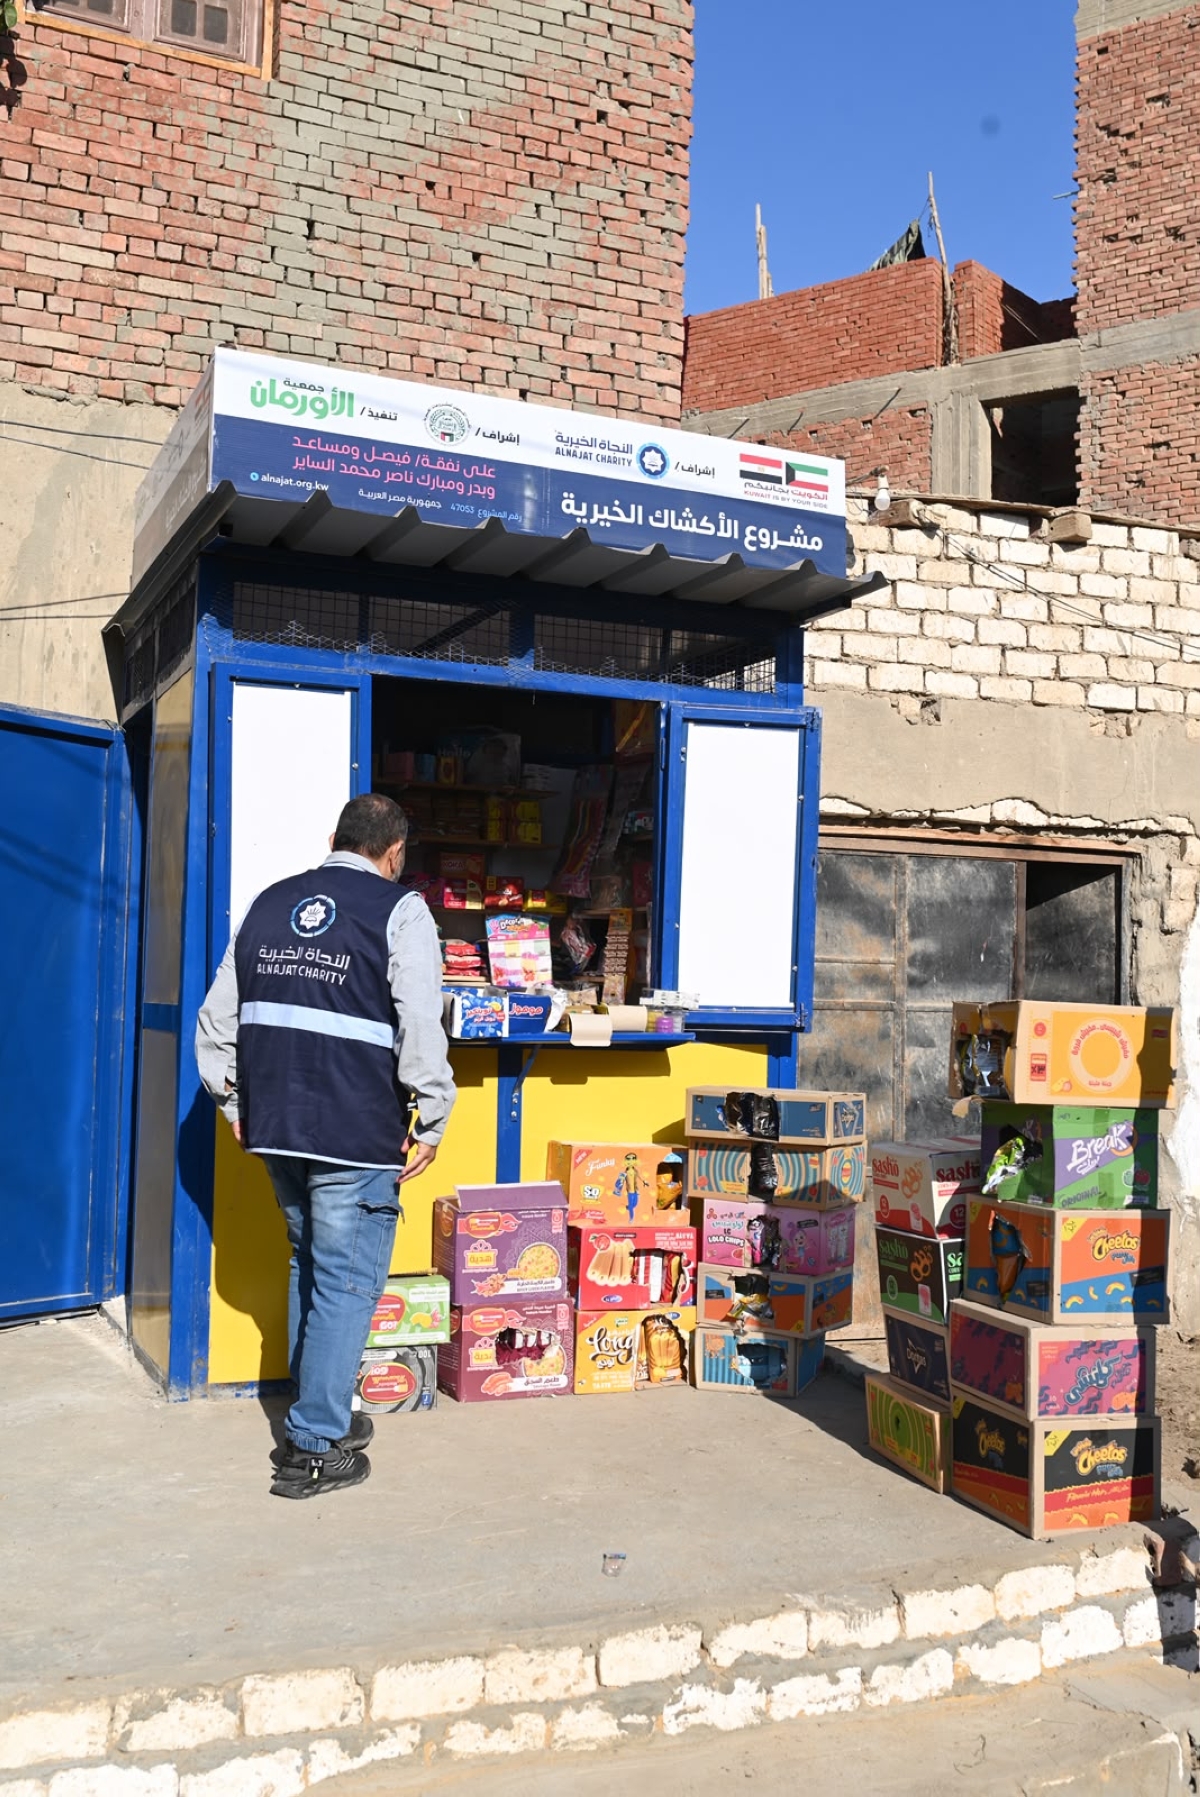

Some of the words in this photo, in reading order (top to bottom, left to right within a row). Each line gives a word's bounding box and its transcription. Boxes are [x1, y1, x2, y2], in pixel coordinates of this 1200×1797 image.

[283, 377, 325, 393] جمعية
[250, 378, 354, 419] الأورمان
[555, 430, 598, 451] الخيرية
[599, 438, 633, 455] النجاة
[292, 453, 335, 472] الساير
[363, 446, 411, 464] فيصل
[555, 446, 593, 461] ALNAJAT
[596, 452, 633, 467] CHARITY
[339, 460, 381, 479] محمد
[383, 469, 413, 484] ناصر
[463, 462, 496, 479] على
[261, 474, 329, 492] alnajat.org.kw
[416, 473, 465, 496] ومبارك
[468, 481, 496, 500] وبدر
[358, 488, 388, 500] العربية
[388, 494, 406, 503] مصر
[407, 495, 442, 509] جمهورية
[744, 490, 771, 499] KUWAIT
[813, 501, 828, 509] SIDE
[791, 489, 828, 501] الكويت
[450, 502, 475, 514] 47053
[561, 491, 643, 528] الخيرية
[508, 513, 522, 523] رقم
[648, 507, 738, 540] الأكشاك
[743, 524, 823, 551] مشروع
[258, 945, 305, 963] الخيرية
[305, 947, 351, 970] النجاة
[256, 963, 298, 976] ALNAJAT
[298, 965, 347, 985] CHARITY
[1066, 1123, 1127, 1171] Break
[954, 1207, 964, 1217] 12
[708, 1235, 724, 1243] LOLO
[725, 1235, 744, 1247] CHIPS
[1092, 1230, 1140, 1261] Cheetos
[1076, 1441, 1128, 1475] Cheetos
